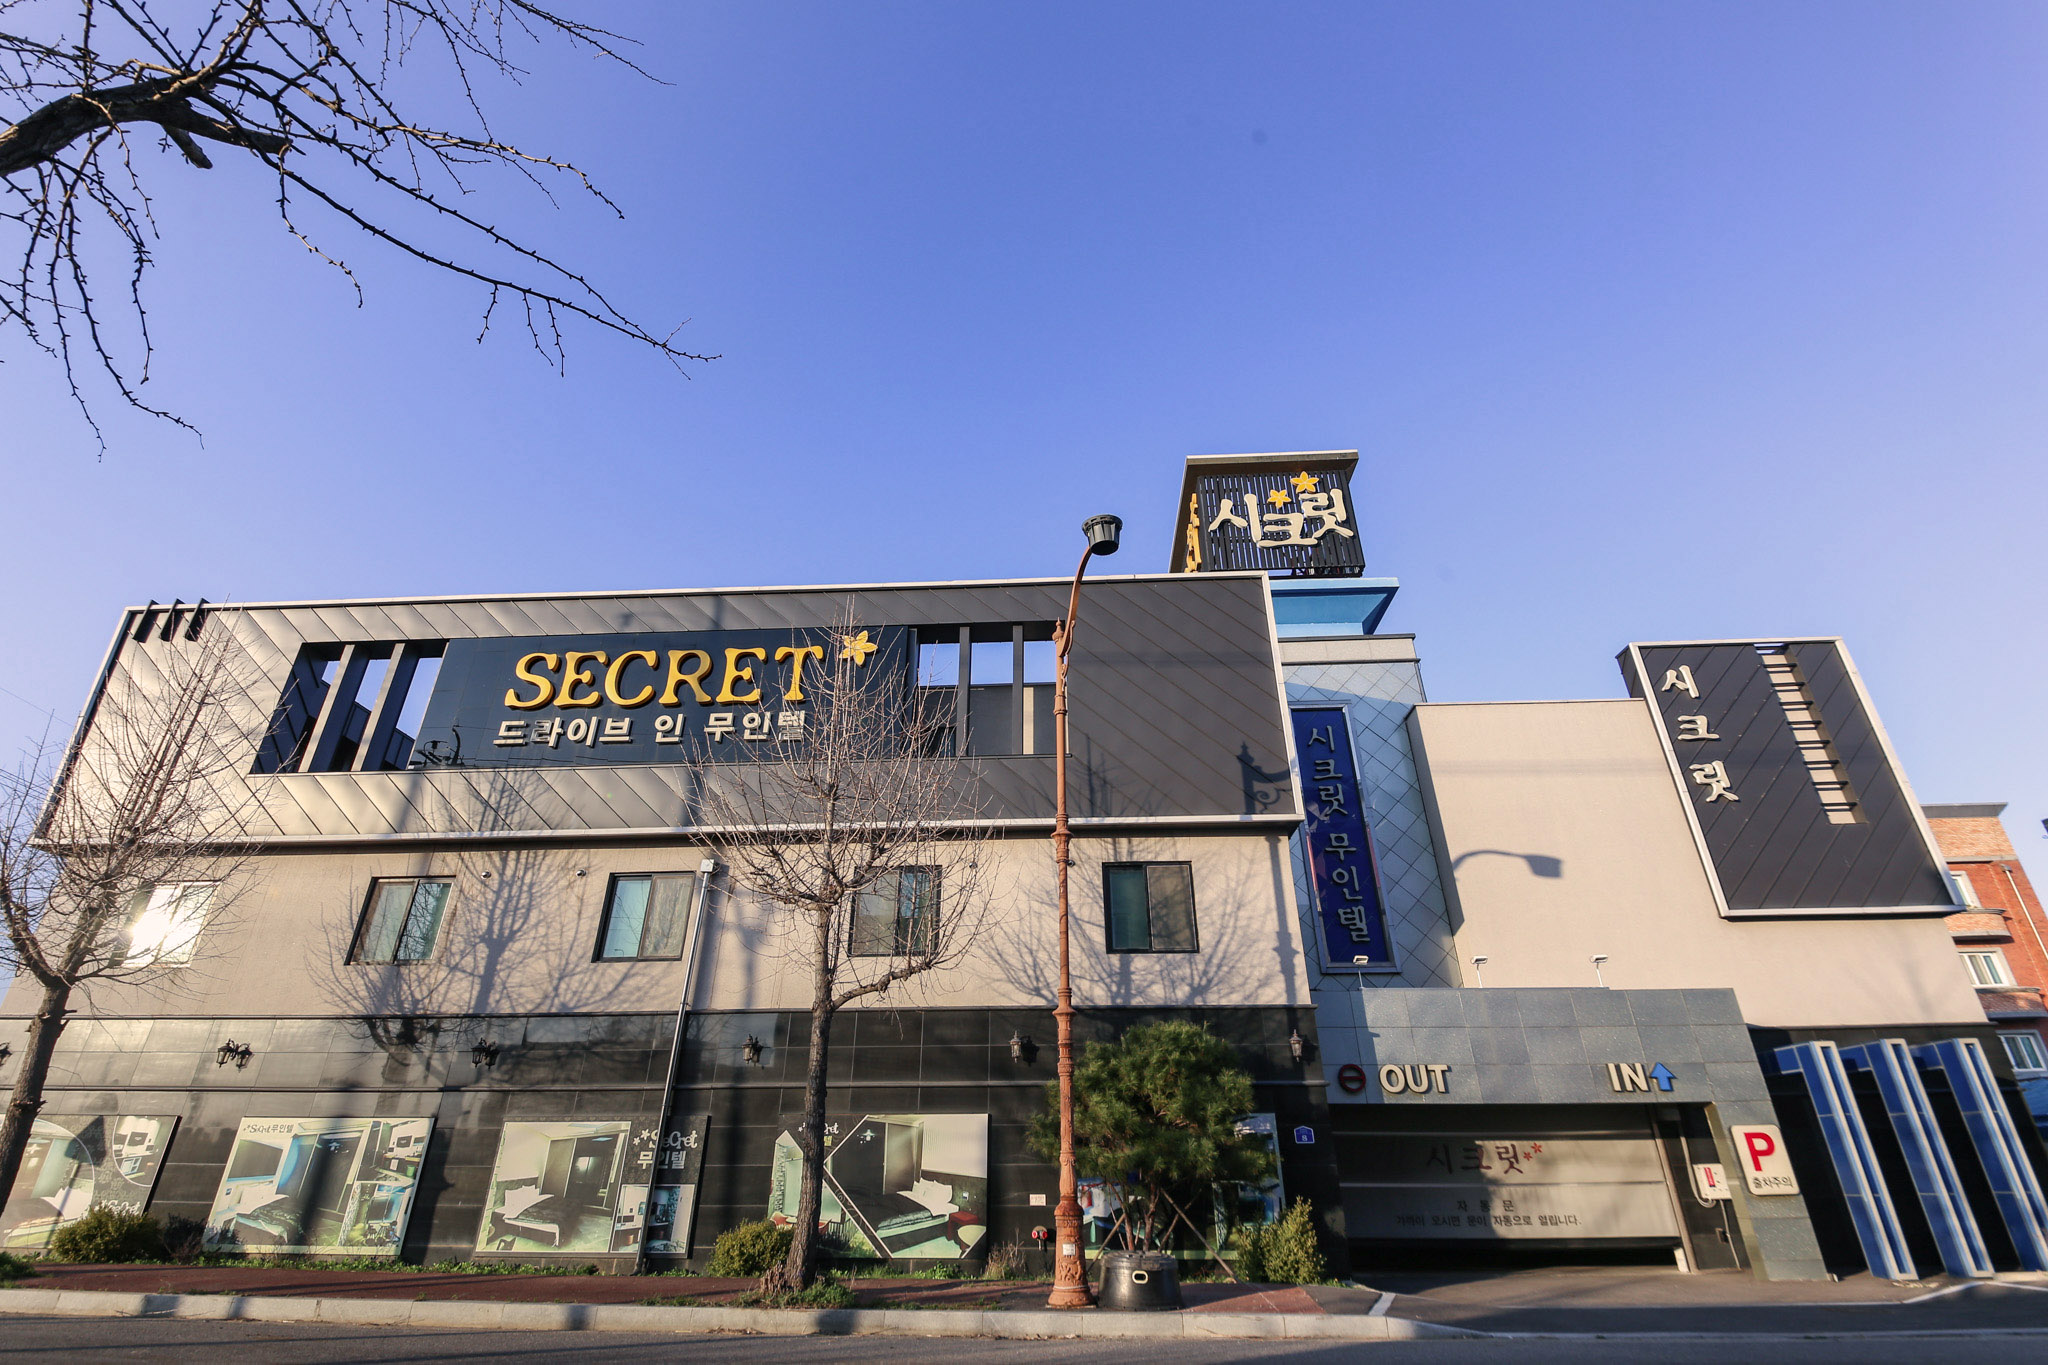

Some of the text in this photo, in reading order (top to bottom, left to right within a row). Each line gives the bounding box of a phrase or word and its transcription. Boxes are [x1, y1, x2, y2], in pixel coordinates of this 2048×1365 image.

[1208, 488, 1354, 548] 시크릿
[504, 646, 824, 707] SECRET
[493, 710, 806, 748] 드라이브 인 무인텔
[1661, 664, 1740, 803] 시크릿
[1308, 725, 1371, 942] 시크릿 무인텔
[1379, 1064, 1449, 1094] OUT
[1606, 1062, 1649, 1093] IN
[1427, 1143, 1524, 1175] 시크릿
[1743, 1132, 1775, 1172] P
[1493, 1214, 1533, 1226] 자동으로
[1538, 1214, 1581, 1226] 열립니다.
